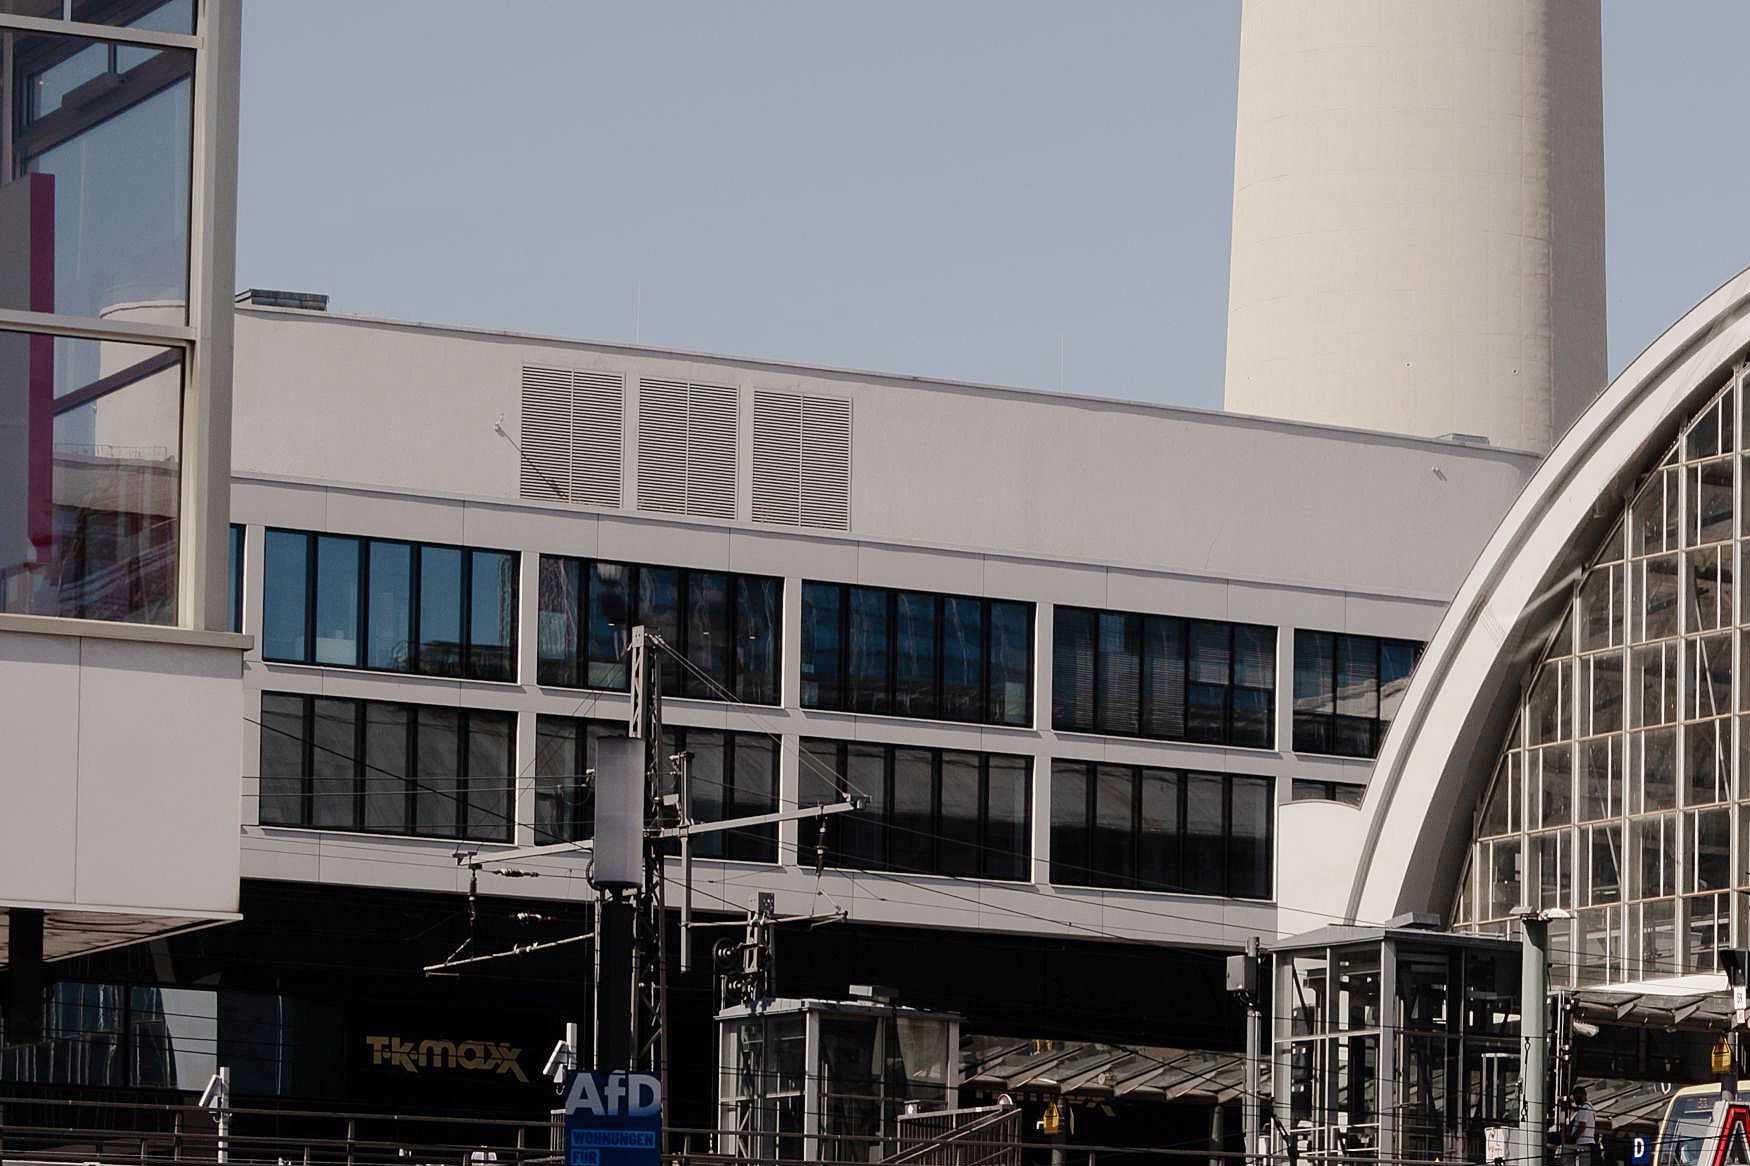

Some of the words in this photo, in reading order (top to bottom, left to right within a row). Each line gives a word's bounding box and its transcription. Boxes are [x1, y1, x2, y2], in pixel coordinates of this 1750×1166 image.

[565, 1069, 661, 1116] AfD
[573, 1131, 654, 1146] WOHNUNGEN
[1634, 1138, 1645, 1159] D
